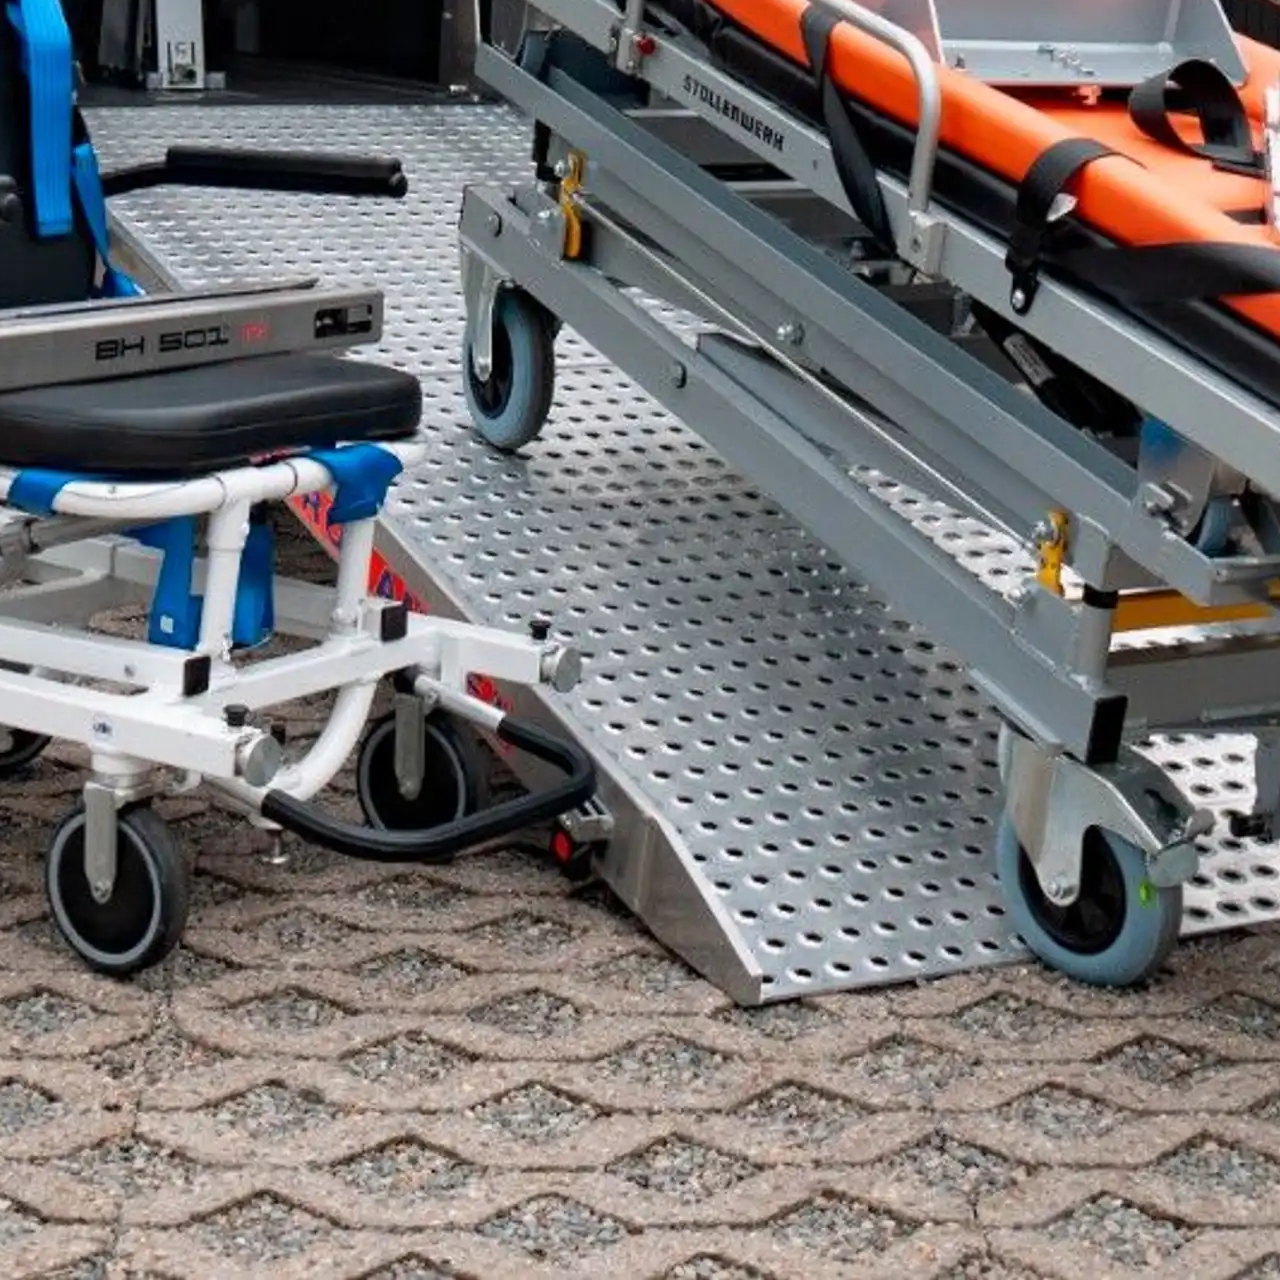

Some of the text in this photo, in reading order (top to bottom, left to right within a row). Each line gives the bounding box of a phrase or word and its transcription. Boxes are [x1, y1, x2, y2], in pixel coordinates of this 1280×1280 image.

[682, 73, 785, 152] STOLLENWERK
[94, 334, 145, 361] BH
[158, 324, 230, 354] 501
